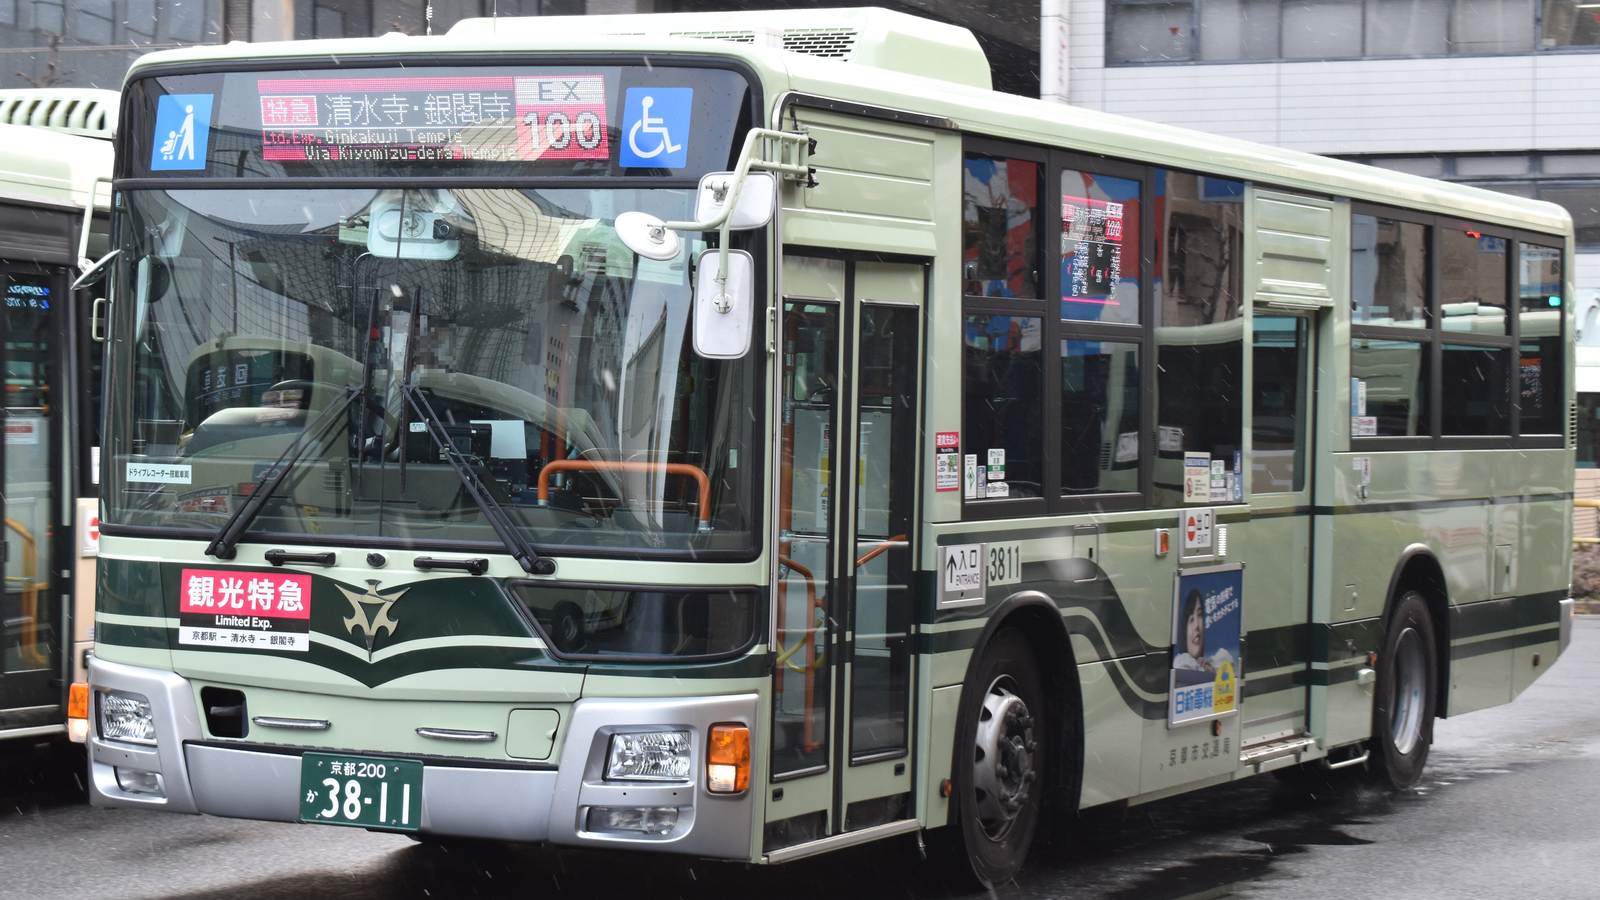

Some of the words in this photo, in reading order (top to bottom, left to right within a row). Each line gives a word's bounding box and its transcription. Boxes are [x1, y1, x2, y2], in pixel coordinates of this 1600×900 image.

[538, 81, 581, 102] EX
[267, 98, 311, 122] 特急
[325, 129, 398, 144] Ginkakuji
[406, 128, 462, 143] Temple
[522, 111, 603, 151] 100
[305, 145, 334, 160] Via
[338, 145, 453, 160] Kiyomizu-dera
[461, 144, 518, 159] Temple
[959, 549, 977, 570] 入口
[990, 545, 1020, 581] 3811
[956, 573, 980, 587] ENTRANCE
[187, 575, 304, 612] 観光特急
[215, 615, 251, 628] Limited
[251, 616, 273, 630] Exp.
[306, 789, 318, 804] か
[320, 777, 411, 824] 38-11
